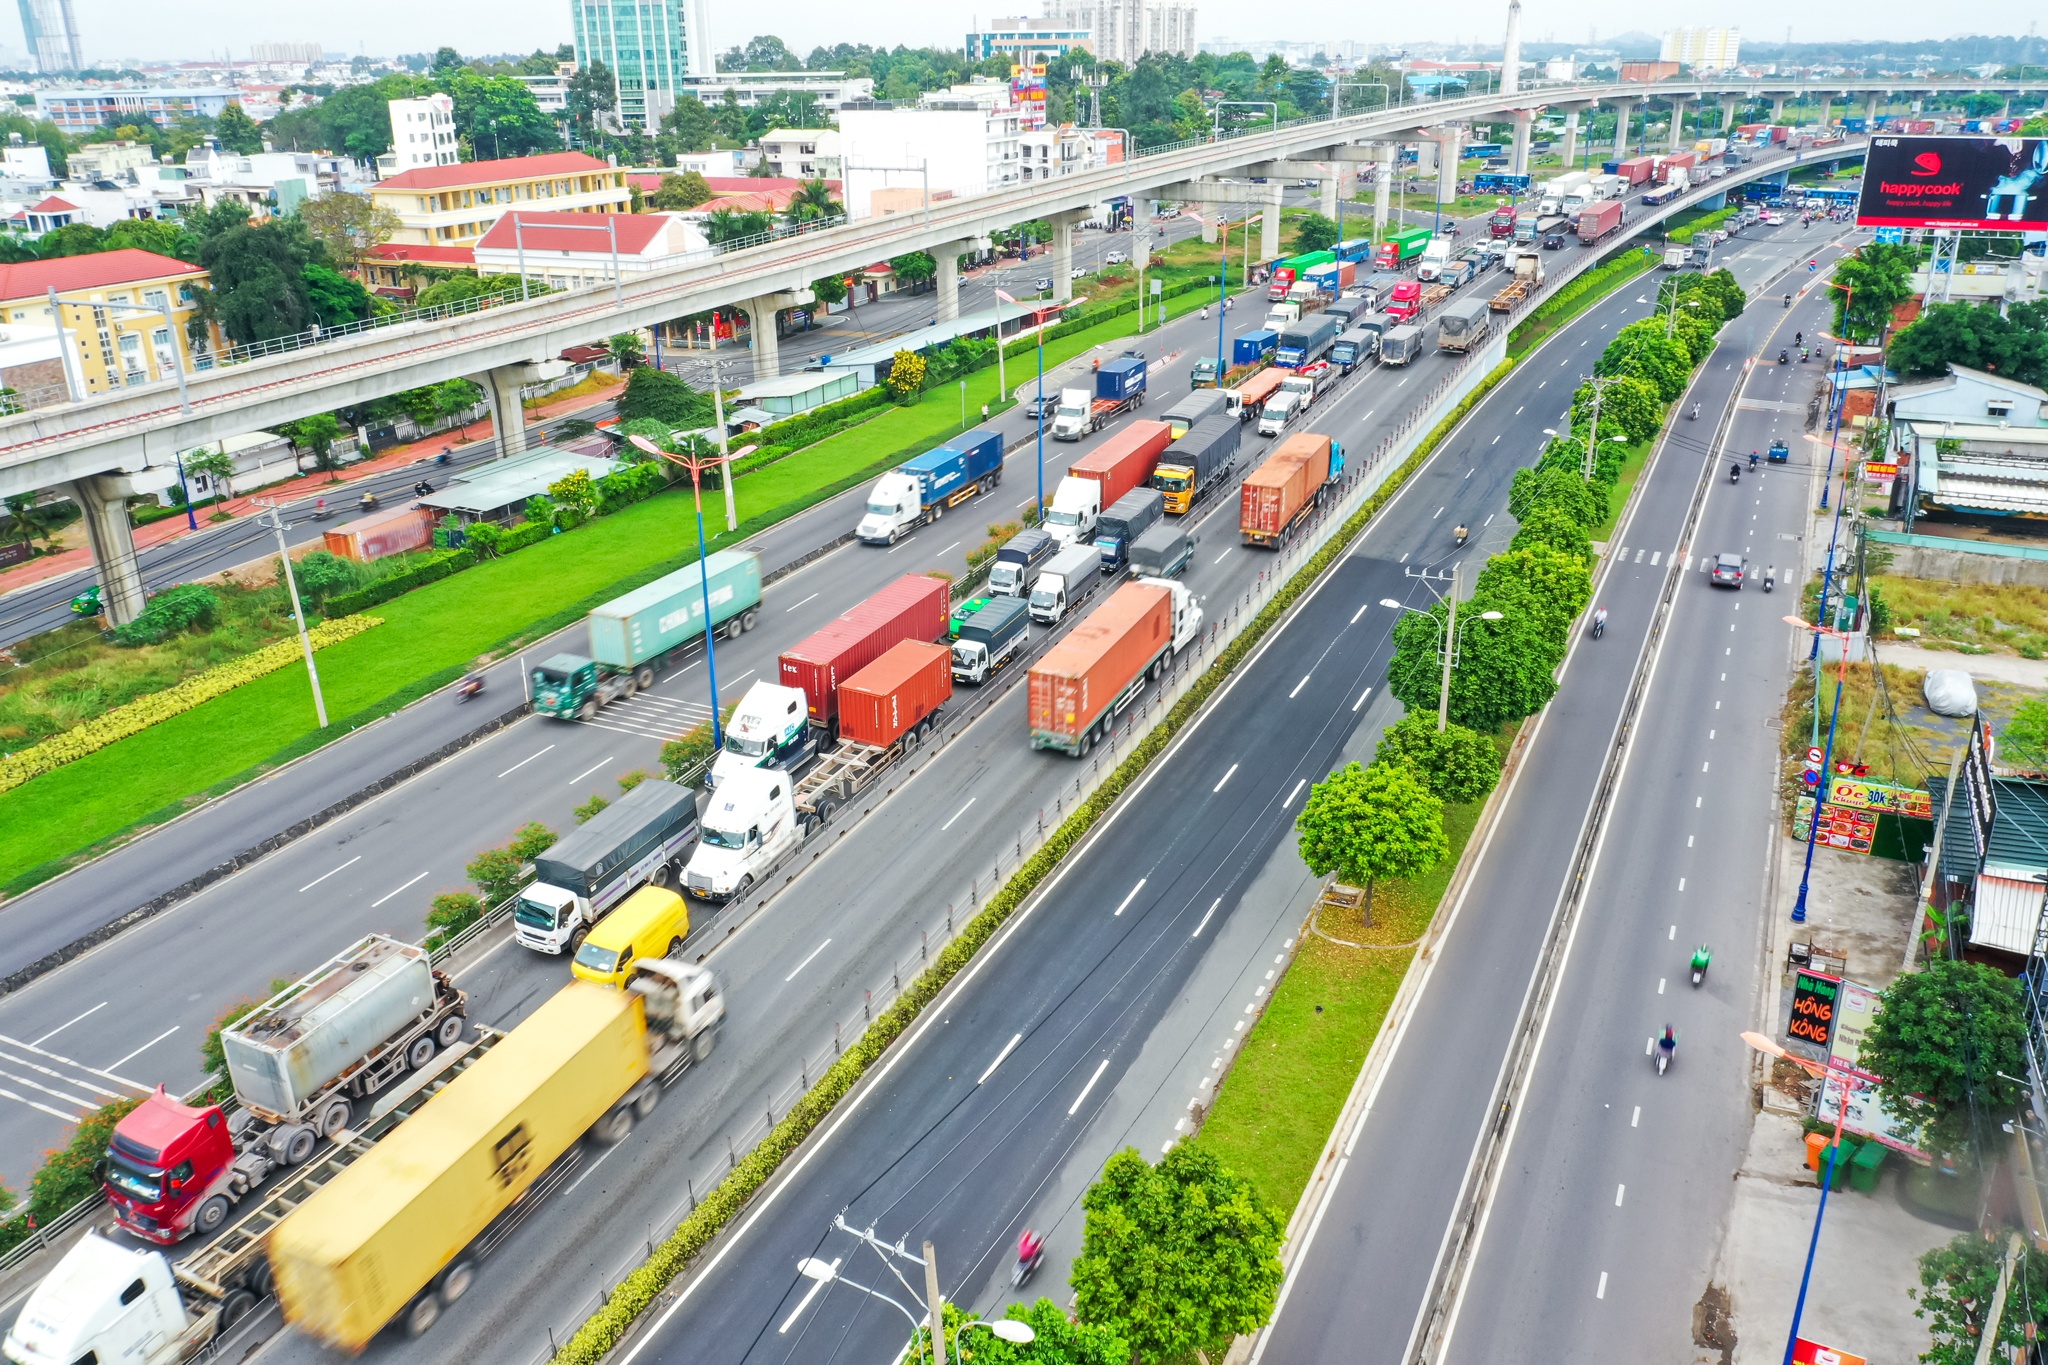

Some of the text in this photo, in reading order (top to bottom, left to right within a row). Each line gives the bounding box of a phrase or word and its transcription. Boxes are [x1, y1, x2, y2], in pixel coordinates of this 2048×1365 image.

[1880, 181, 1961, 197] happycook
[1922, 200, 1941, 208] happy
[783, 663, 798, 673] tex
[1867, 790, 1886, 804] 30k
[1794, 996, 1833, 1020] HỒNG
[1790, 1018, 1828, 1042] KÔNG
